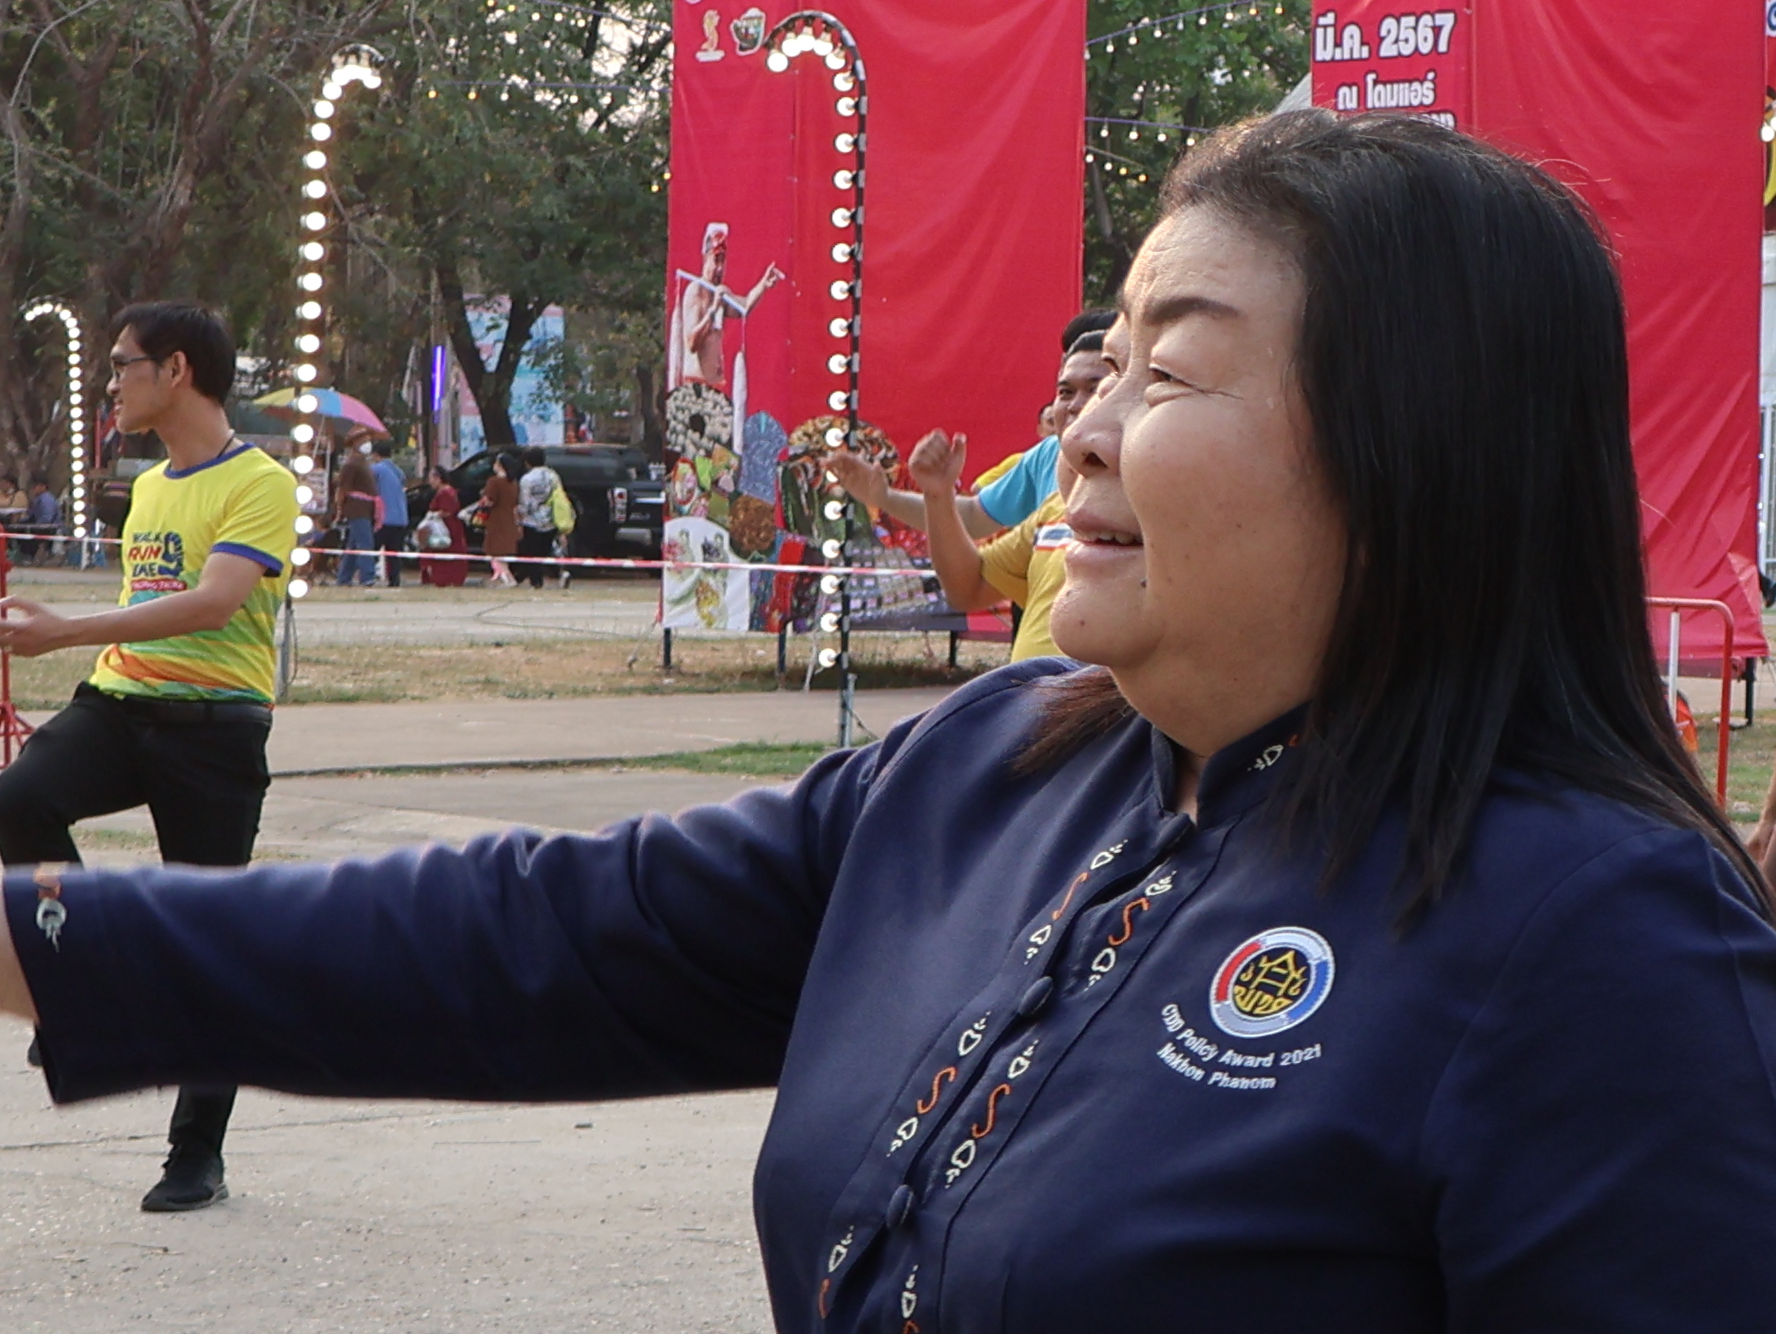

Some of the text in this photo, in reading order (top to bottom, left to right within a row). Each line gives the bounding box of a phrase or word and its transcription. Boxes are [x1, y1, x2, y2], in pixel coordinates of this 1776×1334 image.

[1314, 11, 1457, 61] มี.ค. 2567
[1337, 71, 1437, 111] ณ โดมแอร์
[129, 546, 162, 560] RUN
[1161, 1004, 1322, 1068] CDD Policy Award 2021
[1156, 1042, 1277, 1090] Nakhon Phanom
